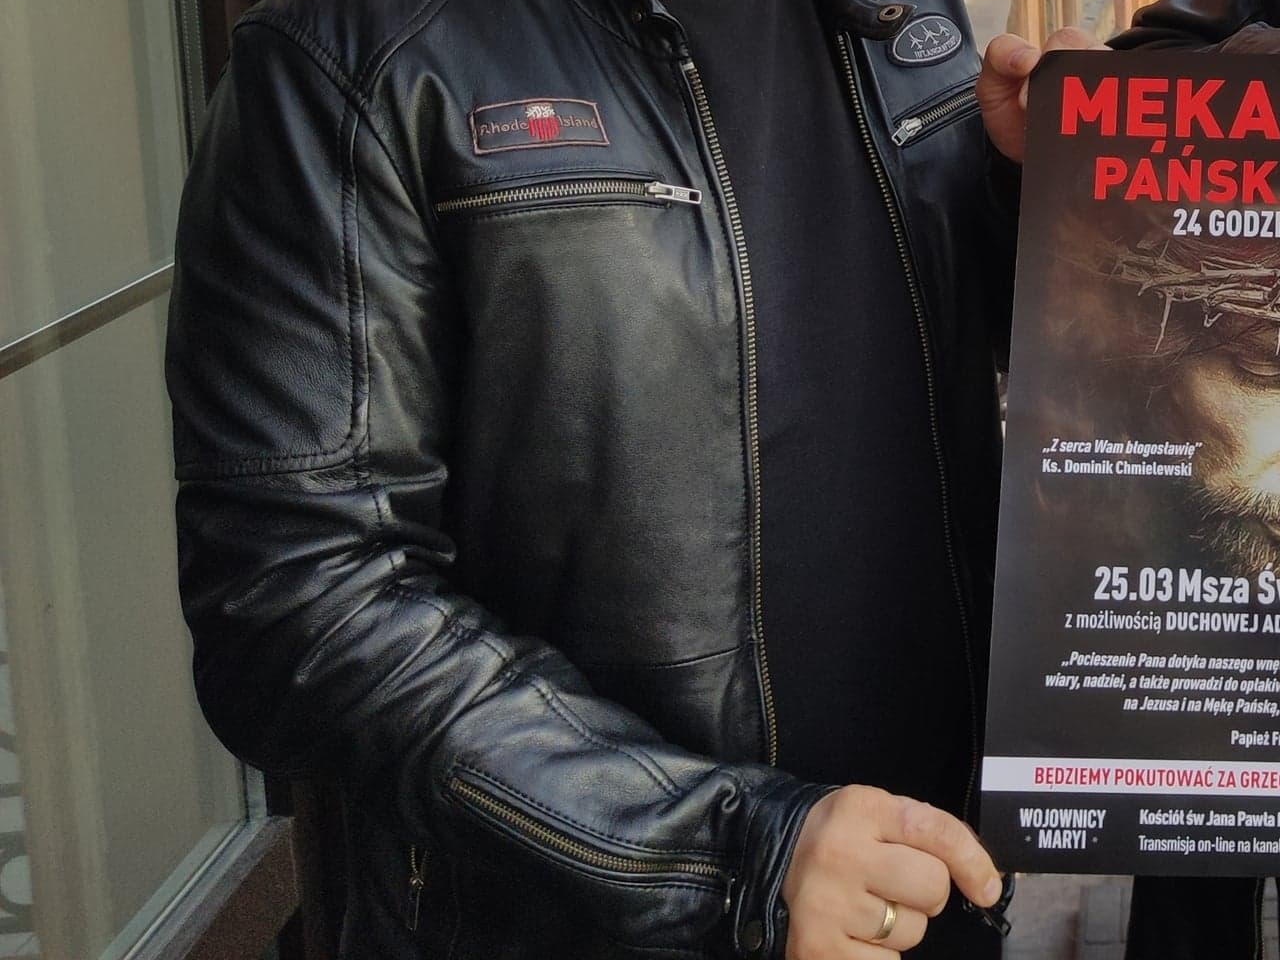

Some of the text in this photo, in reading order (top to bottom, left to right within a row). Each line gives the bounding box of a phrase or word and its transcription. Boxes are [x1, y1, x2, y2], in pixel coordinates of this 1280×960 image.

[1172, 208, 1203, 236] 24
[1060, 441, 1092, 454] serca
[1094, 439, 1124, 455] Wam
[1042, 458, 1193, 477] Ks. Dominik Chmielewski
[1093, 565, 1174, 602] 25.03
[1177, 568, 1250, 604] Msza
[1064, 613, 1073, 628] z
[1076, 610, 1162, 634] możliwością
[1165, 612, 1259, 633] DUCHOWEJ
[1137, 653, 1167, 669] Pana
[1168, 654, 1206, 672] dotyka
[1207, 656, 1254, 673] naszego
[1045, 672, 1080, 690] wiary,
[1083, 673, 1126, 691] nadziei,
[1129, 677, 1137, 689] a
[1139, 674, 1171, 690] także
[1171, 676, 1223, 692] prowadzi
[1224, 677, 1239, 692] do
[1123, 697, 1138, 711] na
[1139, 696, 1180, 712] Jezusa
[1180, 697, 1187, 712] i
[1187, 699, 1202, 713] na
[1203, 697, 1234, 716] Mękę
[1235, 698, 1280, 717] Pańską,
[1230, 730, 1271, 748] Papież
[1114, 767, 1214, 787] POKUTOWAĆ
[1217, 771, 1237, 788] ZA
[1019, 807, 1107, 829] WOJOWNICY
[1138, 809, 1185, 826] Kościół
[1206, 811, 1236, 827] Jana
[1237, 811, 1275, 828] Pawła
[1038, 829, 1087, 849] MARYI
[1138, 835, 1195, 855] Transmisja
[1197, 836, 1235, 853] on-line
[1237, 839, 1250, 853] na
